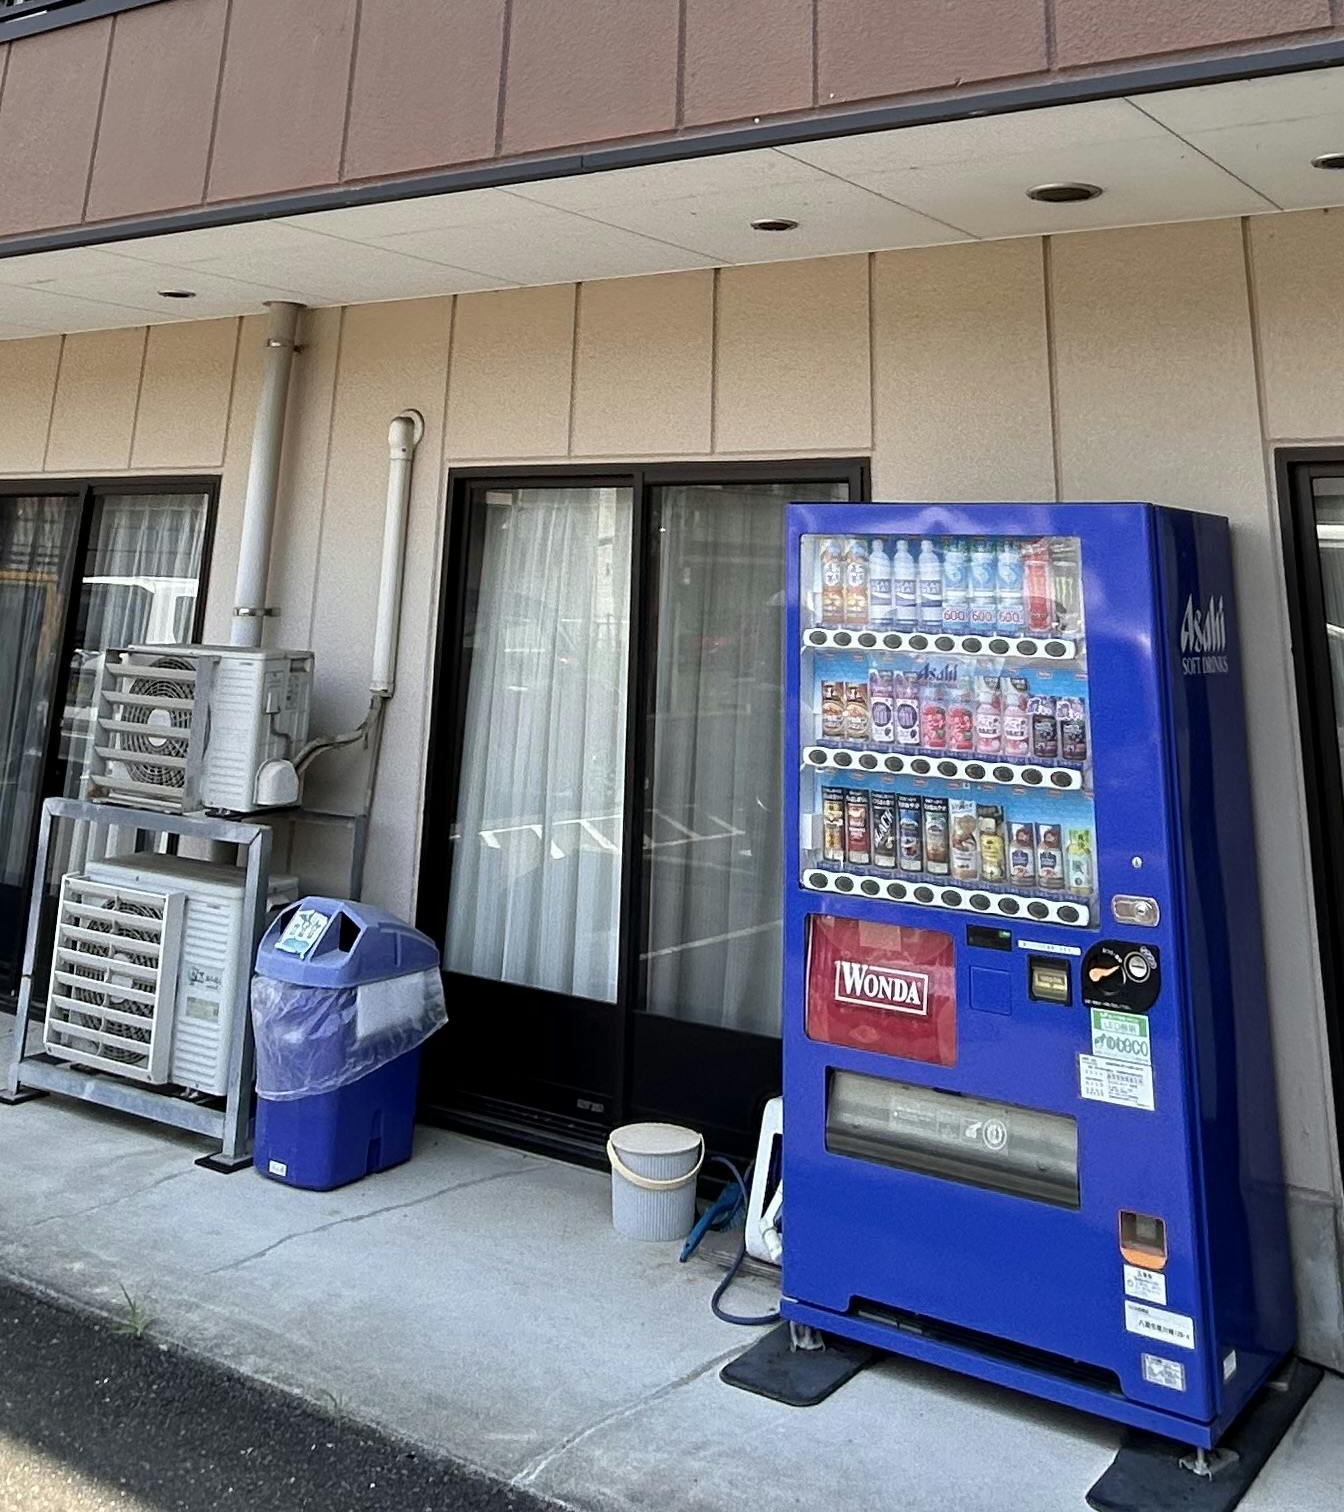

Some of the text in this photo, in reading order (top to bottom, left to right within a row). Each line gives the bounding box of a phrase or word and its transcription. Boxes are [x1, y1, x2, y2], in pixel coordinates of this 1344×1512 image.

[1180, 592, 1226, 653] Asahi
[916, 662, 958, 682] Asahi
[1182, 656, 1200, 675] SOFT
[841, 960, 921, 1005] WONDA
